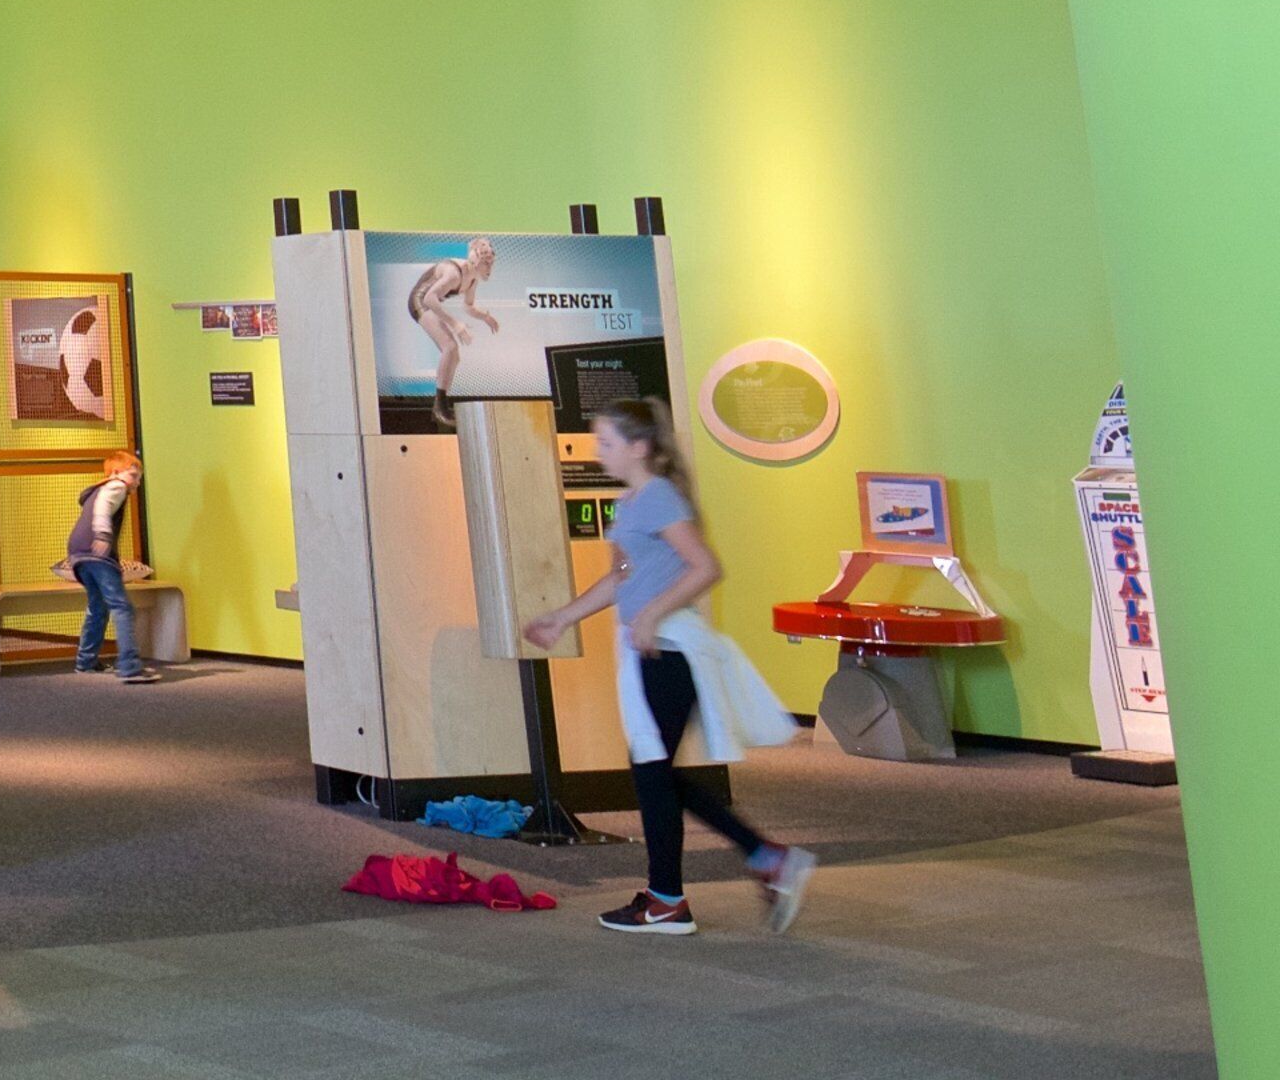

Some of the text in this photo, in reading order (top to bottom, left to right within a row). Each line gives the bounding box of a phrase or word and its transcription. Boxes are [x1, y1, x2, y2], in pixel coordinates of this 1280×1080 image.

[529, 293, 613, 309] STRENGTH
[601, 312, 633, 330] TEST
[1099, 503, 1139, 513] SPACE
[1091, 512, 1143, 524] SHUTTL
[1112, 526, 1154, 647] SCALE
